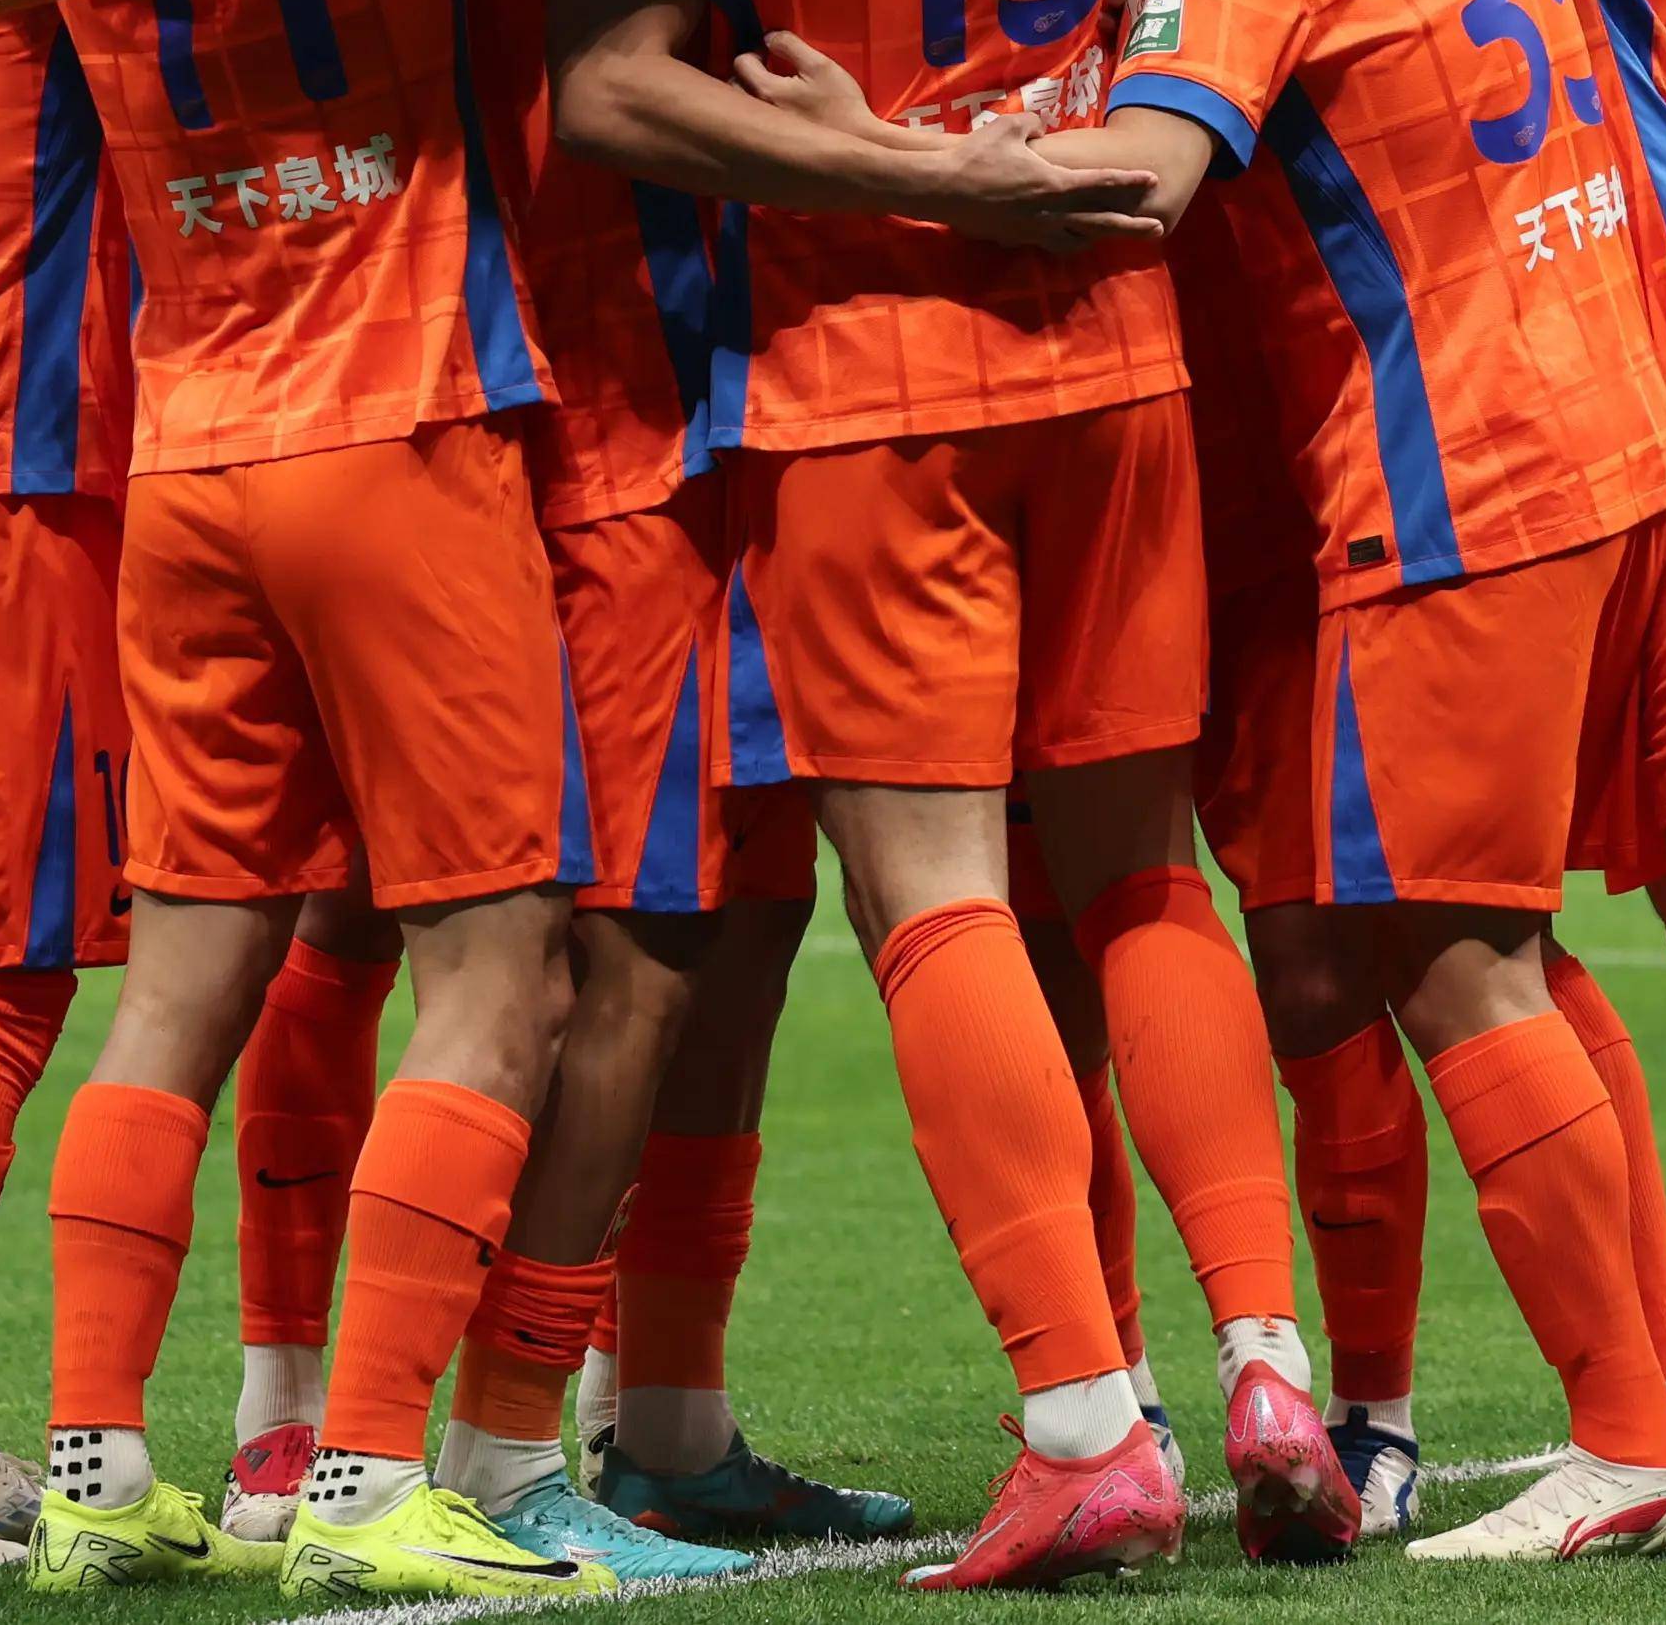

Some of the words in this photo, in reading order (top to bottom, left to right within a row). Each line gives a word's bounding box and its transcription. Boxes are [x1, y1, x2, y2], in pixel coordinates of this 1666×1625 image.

[166, 132, 404, 238] 天下泉城
[94, 748, 130, 867] 1
